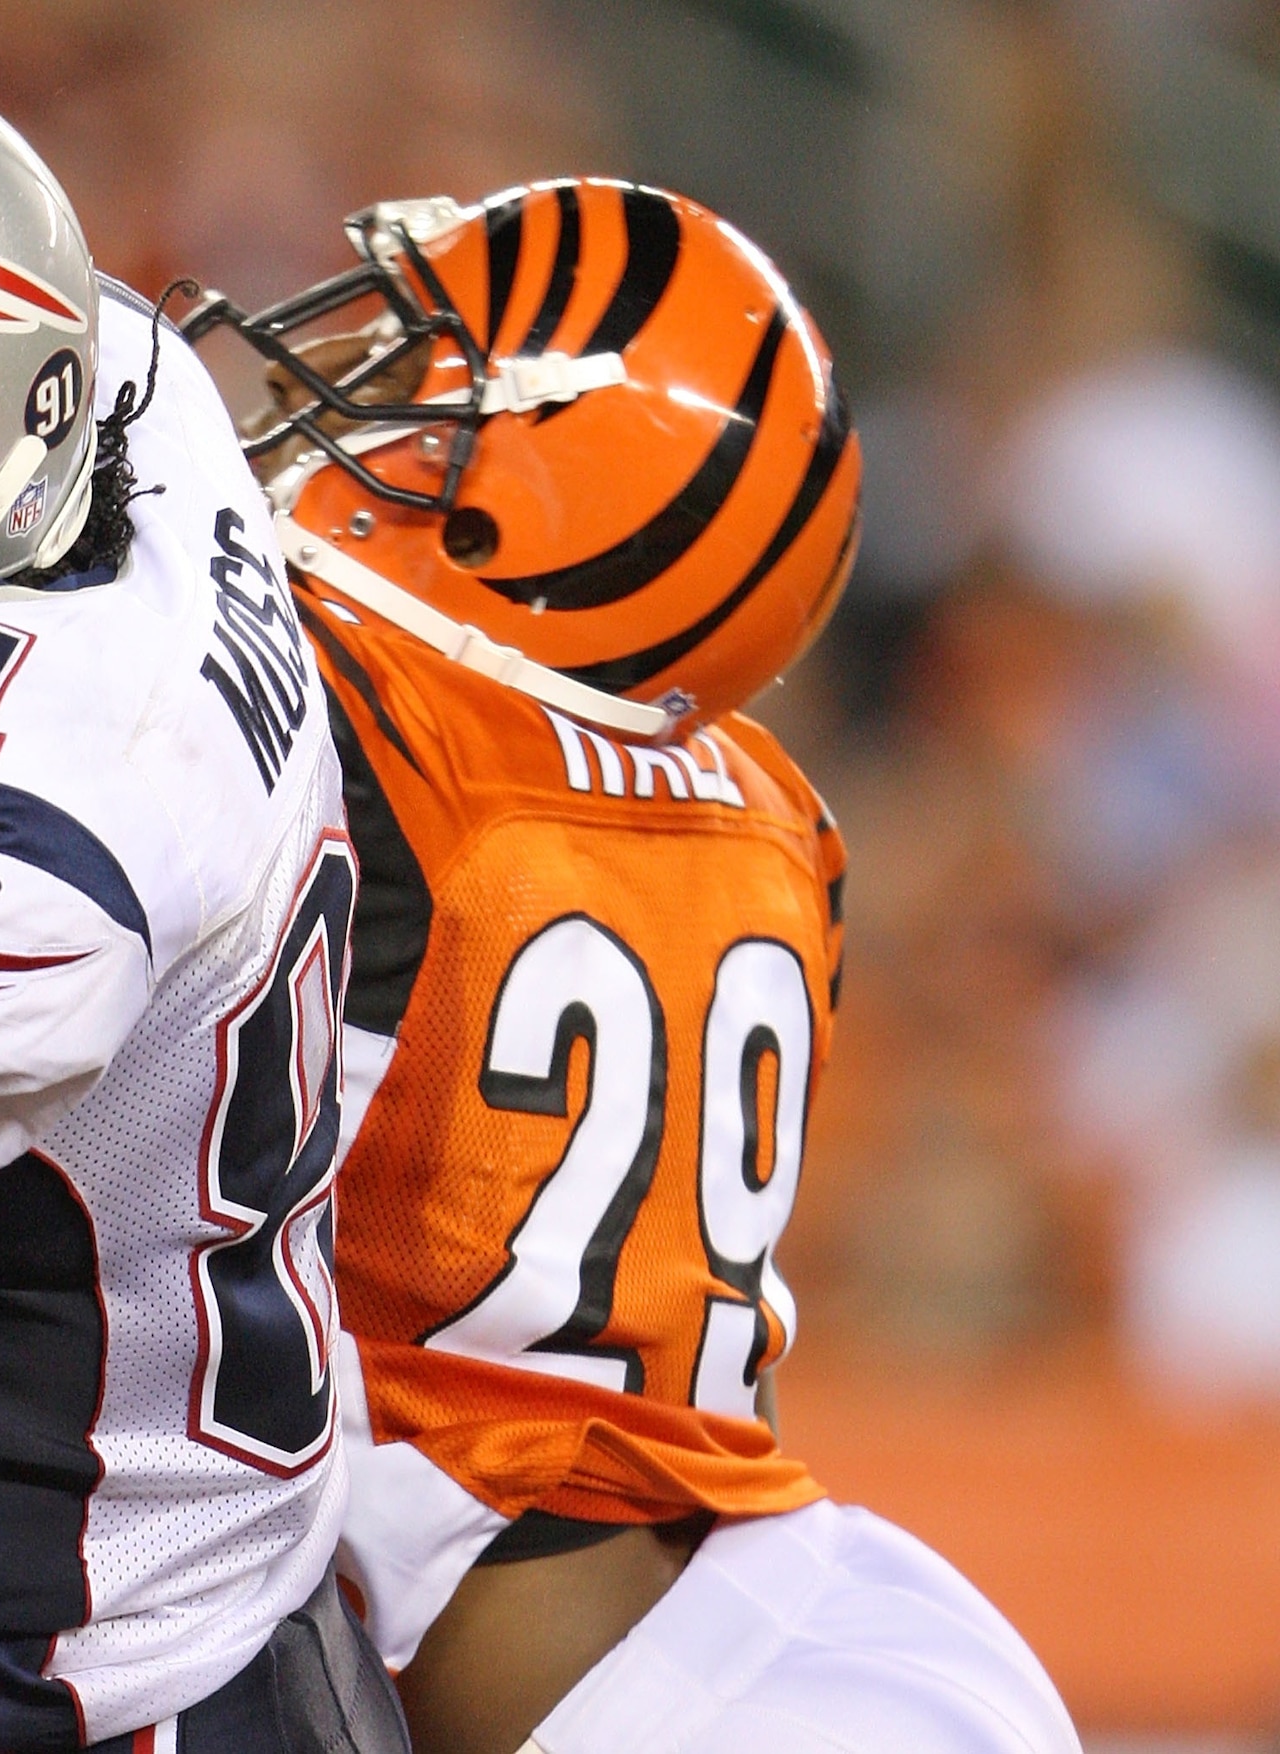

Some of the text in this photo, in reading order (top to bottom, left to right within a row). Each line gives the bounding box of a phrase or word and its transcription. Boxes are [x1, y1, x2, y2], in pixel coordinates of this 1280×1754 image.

[36, 363, 75, 436] 91
[10, 502, 42, 534] NFL
[415, 911, 813, 1422] 29
